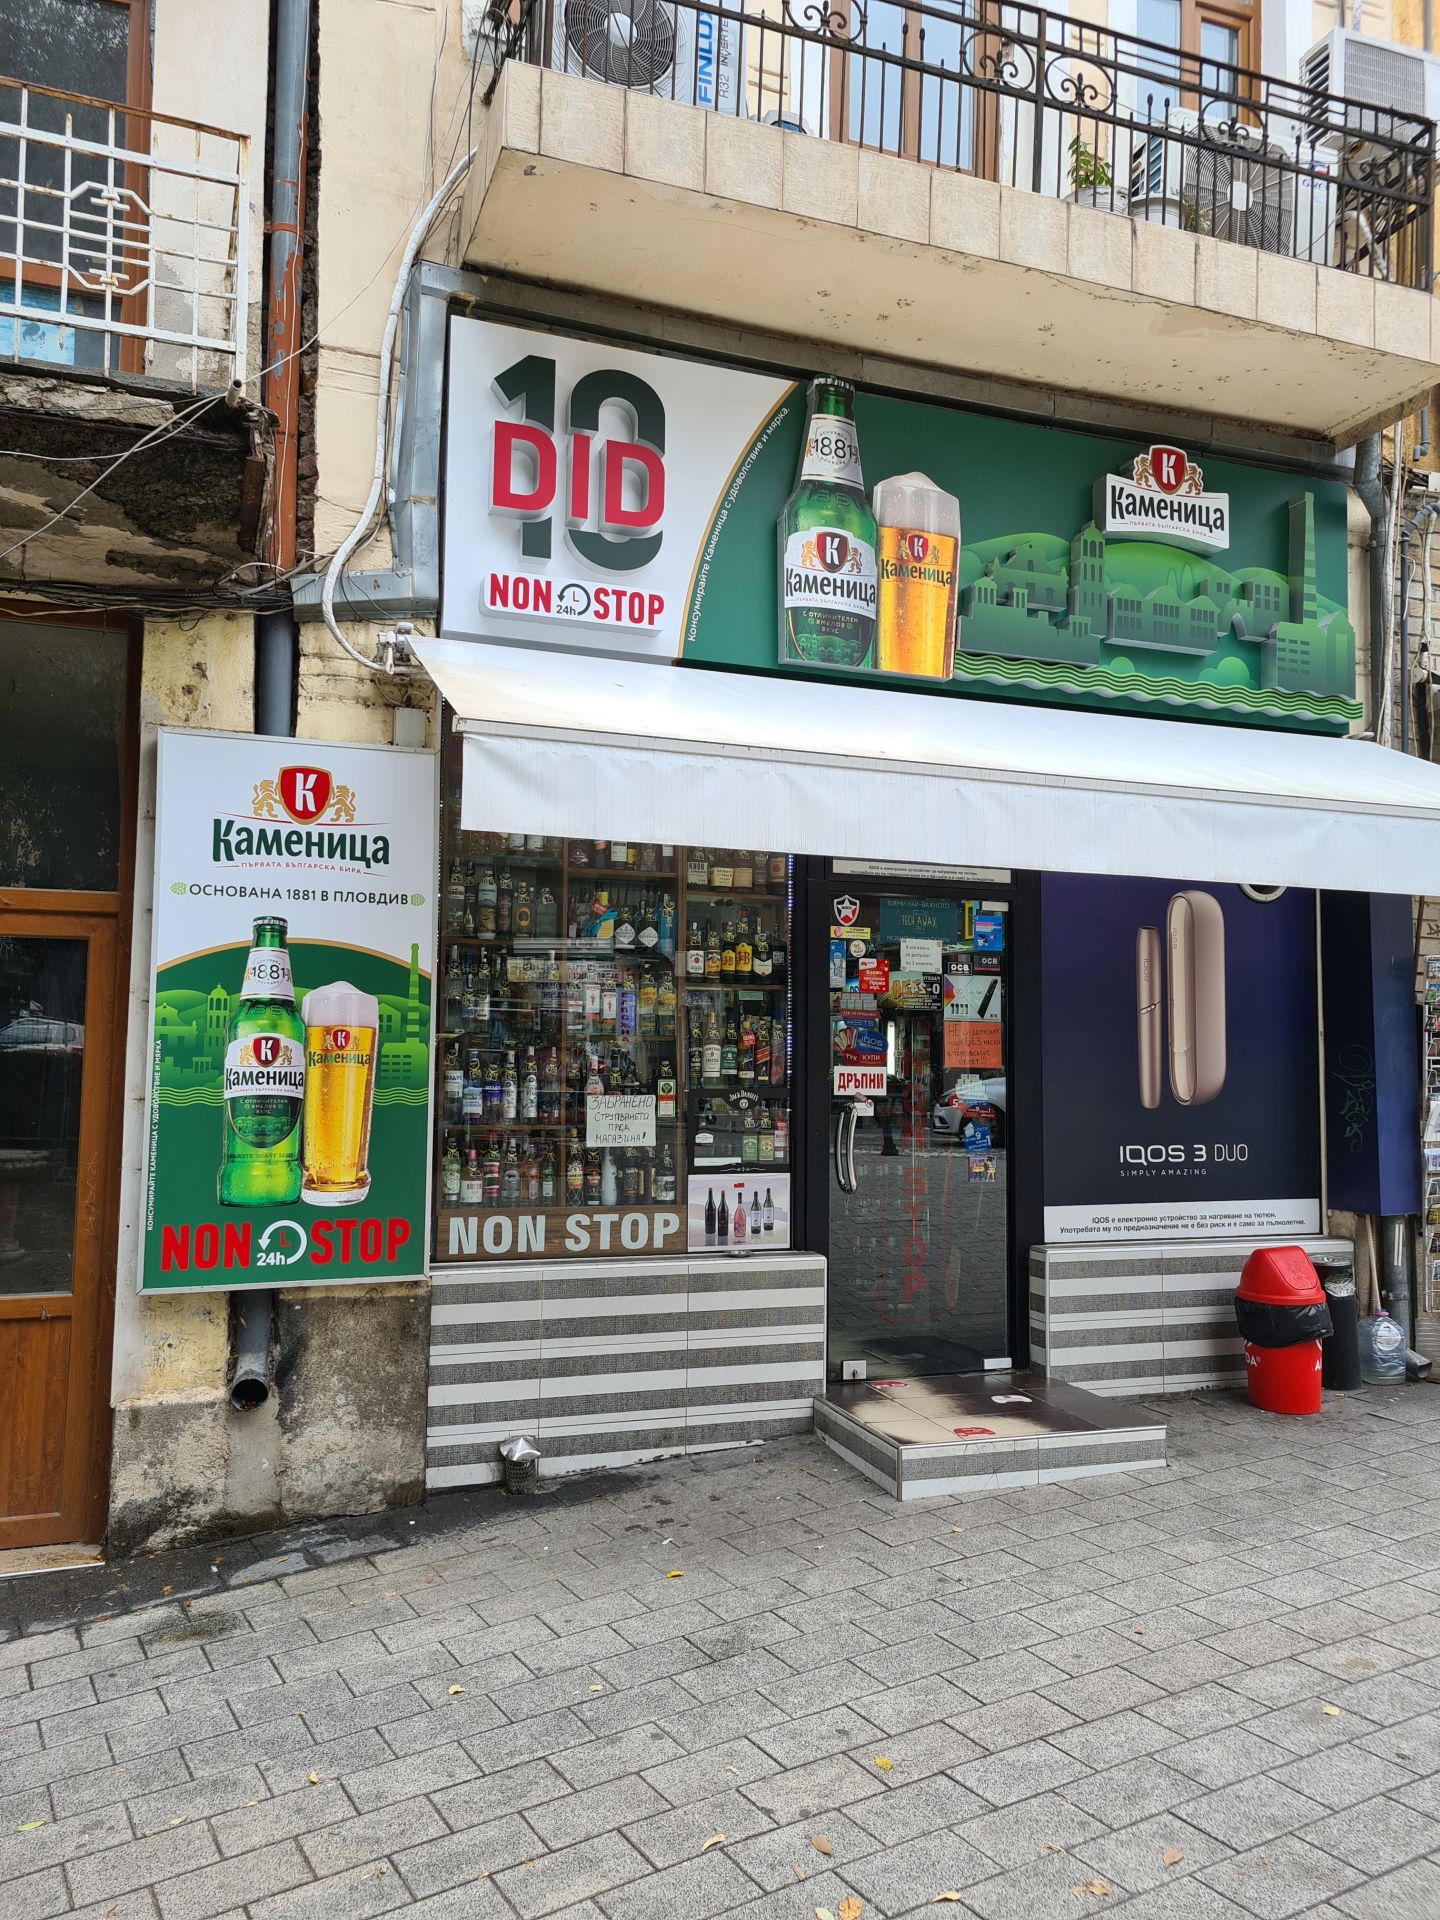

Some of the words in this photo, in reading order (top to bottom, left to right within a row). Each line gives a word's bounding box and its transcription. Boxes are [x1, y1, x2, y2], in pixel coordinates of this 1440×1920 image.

[720, 17, 731, 66] INVERTE
[719, 74, 729, 98] R32
[814, 436, 853, 458] 1881
[493, 420, 665, 527] DID
[1162, 453, 1177, 486] К
[1111, 485, 1225, 533] Каменица
[687, 563, 711, 642] Консумирайте
[703, 509, 728, 561] Каменица
[728, 442, 763, 502] удоволствие
[761, 434, 769, 443] и
[766, 407, 790, 435] мярка.
[1129, 520, 1156, 528] ПЪРВАТА
[1157, 523, 1190, 533] БЪЛГАРСКА
[825, 536, 840, 566] К
[881, 559, 953, 587] Каменица
[490, 573, 551, 612] NON
[556, 605, 576, 616] 24h
[593, 587, 664, 625] STOP
[785, 568, 876, 607] Каменица
[295, 772, 318, 813] К
[212, 818, 390, 869] Каменица
[241, 861, 282, 869] ПЪРВАТА
[285, 861, 336, 872] БЪЛГАРСКА
[339, 866, 362, 875] БИРА
[189, 883, 282, 900] ОСНОВАНА
[286, 888, 316, 901] 1881
[321, 891, 329, 902] В
[333, 890, 408, 906] ПЛОВДИВ
[252, 964, 286, 979] 1881
[861, 1035, 883, 1047] IQOS
[949, 1024, 960, 1036] НЕ
[260, 1040, 273, 1060] К
[309, 1051, 370, 1066] Каменица
[225, 1067, 304, 1090] Каменица
[837, 1072, 884, 1091] ДРЪПНИ
[589, 1095, 653, 1110] ЗАБРАНЕНО
[608, 1123, 630, 1131] ПРЕД
[976, 1131, 981, 1139] 9
[150, 1131, 158, 1171] КАМЕНИЦА
[1120, 1145, 1185, 1165] IQOS
[1193, 1144, 1207, 1161] 3
[1214, 1143, 1248, 1161] DUO
[1161, 1168, 1207, 1176] AMAZING
[147, 1172, 156, 1231] КОНСУМИРАЙТЕ
[1060, 1226, 1101, 1234] Употребата
[1123, 1223, 1179, 1232] предназначение
[1092, 1216, 1110, 1224] IQOS
[1118, 1216, 1157, 1224] електронно
[1159, 1214, 1198, 1222] устройство
[1208, 1213, 1243, 1221] нагряване
[161, 1222, 251, 1272] NON
[256, 1252, 287, 1267] 24h
[309, 1217, 411, 1265] STOP
[448, 1215, 546, 1255] NON
[564, 1212, 680, 1252] STOP
[903, 1167, 926, 1303] STOP
